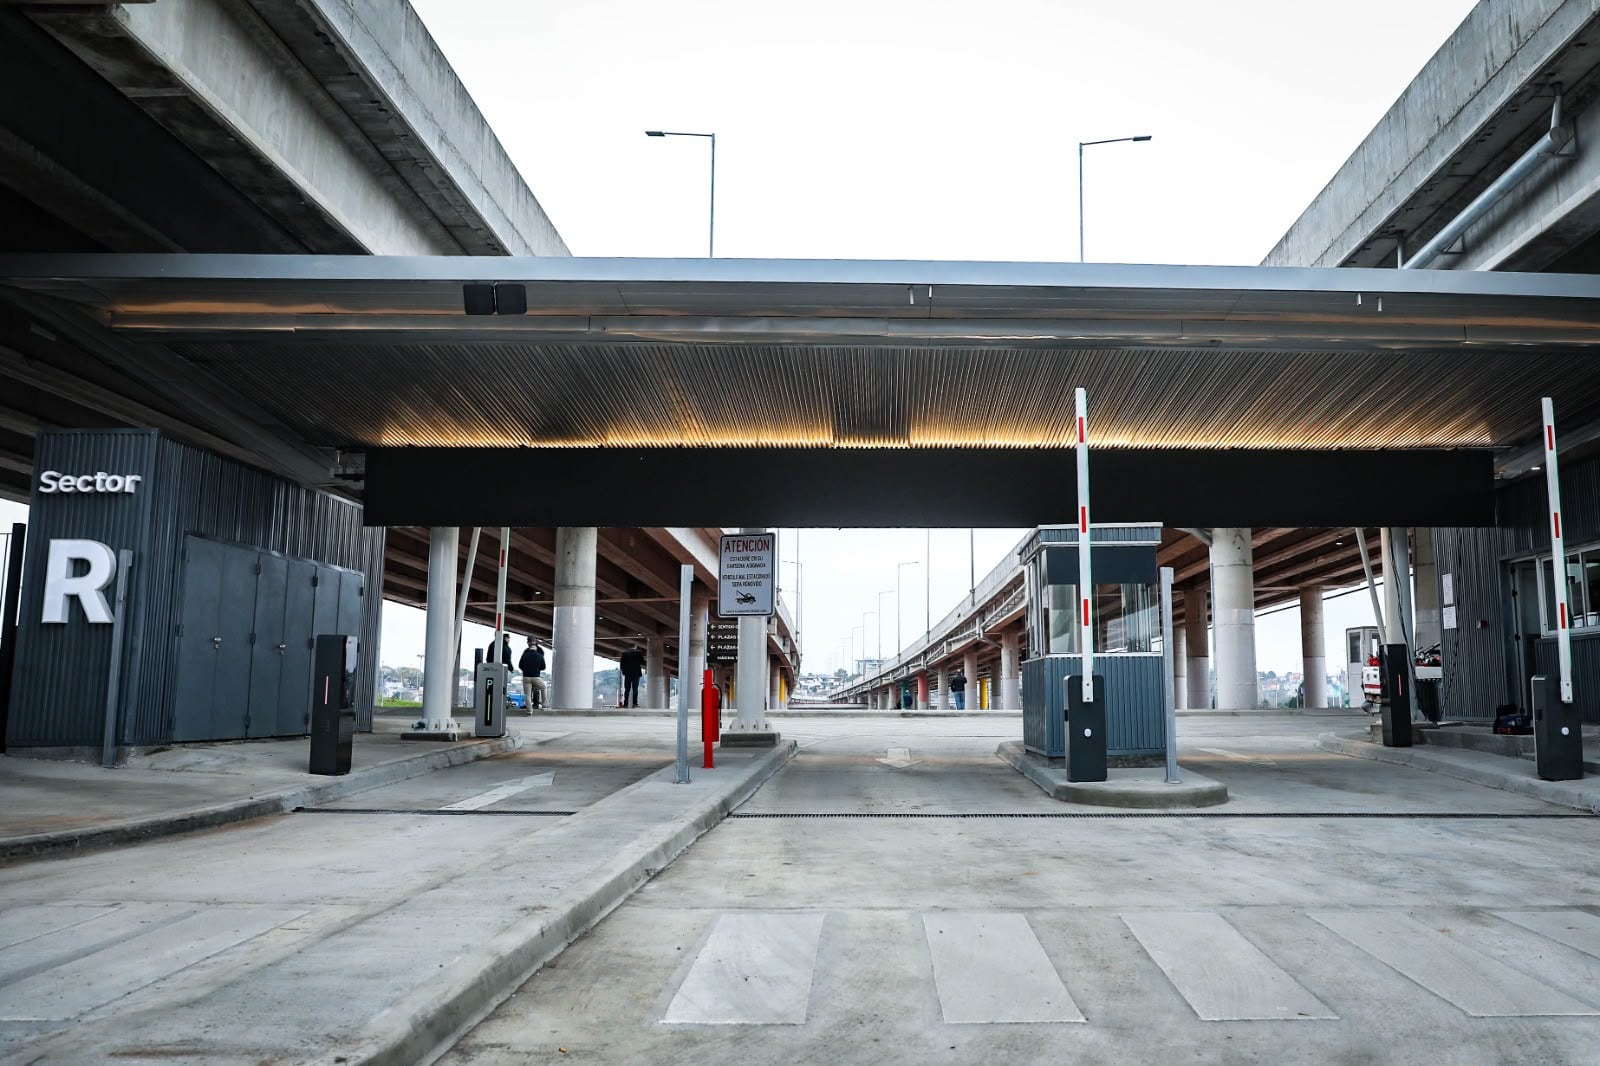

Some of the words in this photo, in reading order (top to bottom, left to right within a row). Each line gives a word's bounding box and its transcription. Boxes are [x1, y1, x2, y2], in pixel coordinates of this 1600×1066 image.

[38, 470, 142, 494] Sector
[724, 536, 770, 552] ATENCIÓN
[41, 538, 117, 624] R
